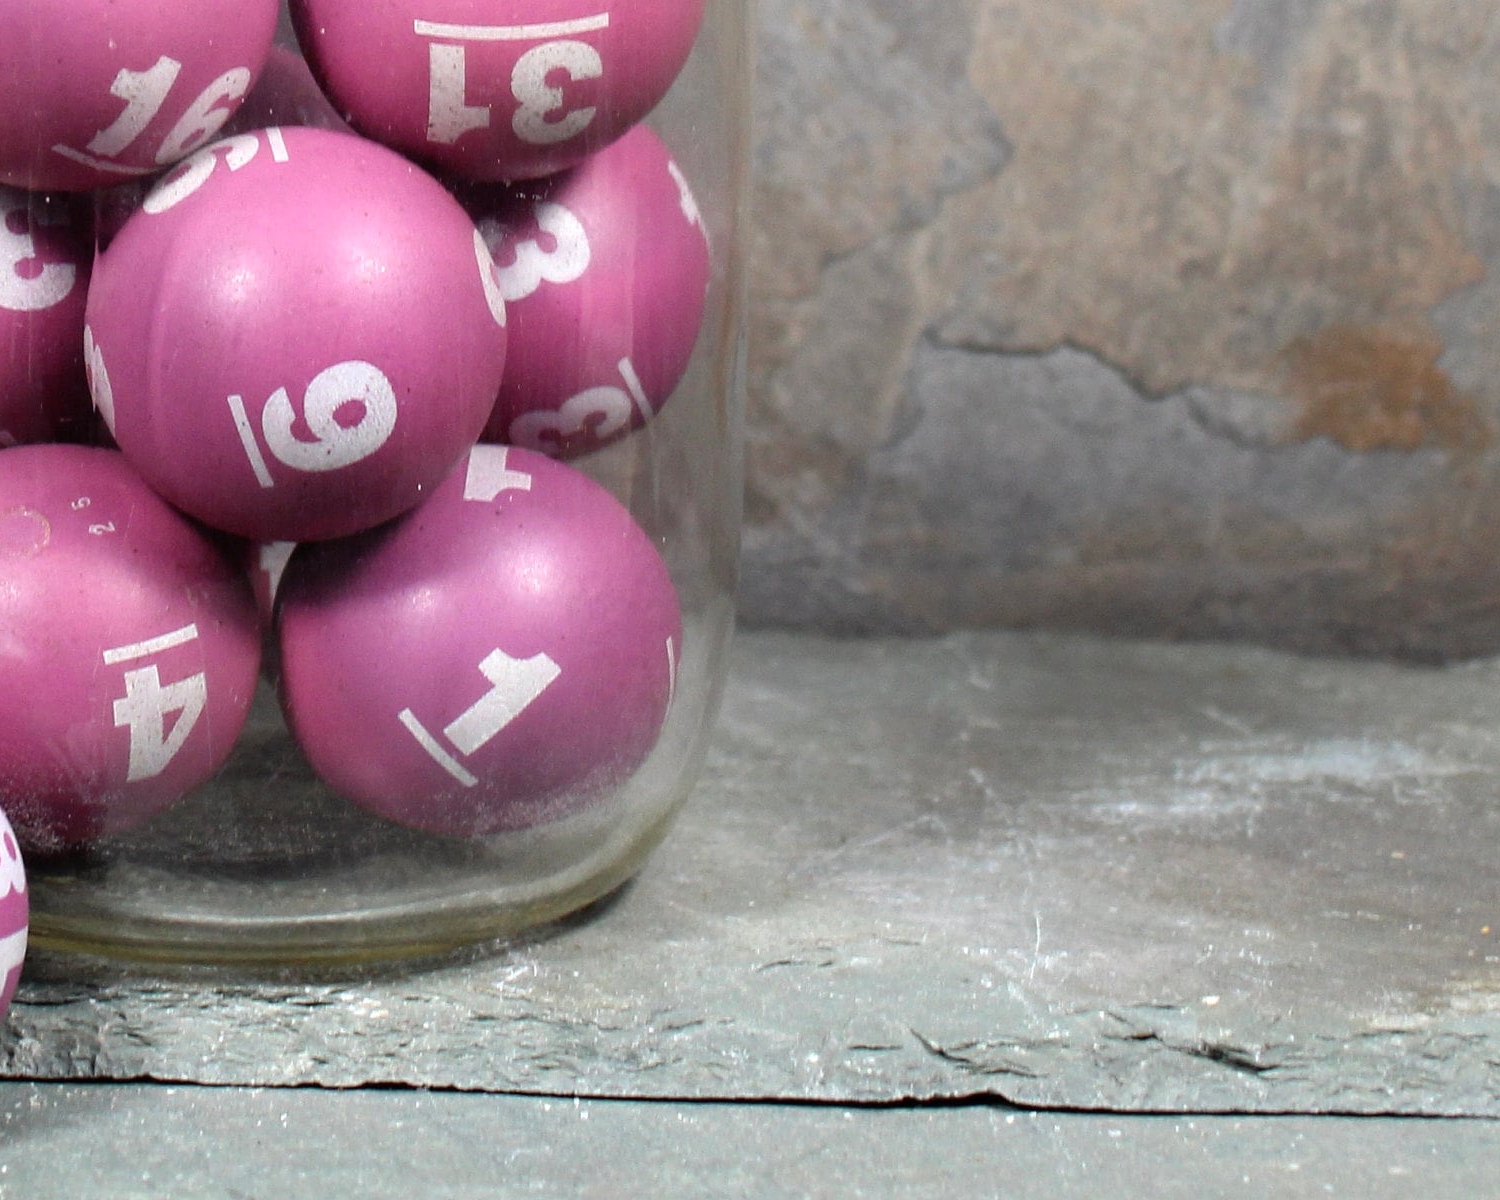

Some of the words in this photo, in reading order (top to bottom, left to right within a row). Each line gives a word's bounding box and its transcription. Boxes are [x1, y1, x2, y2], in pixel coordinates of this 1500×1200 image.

[86, 54, 251, 164] 16
[426, 39, 604, 145] 31
[111, 664, 208, 783] 4
[443, 646, 563, 757] 1
